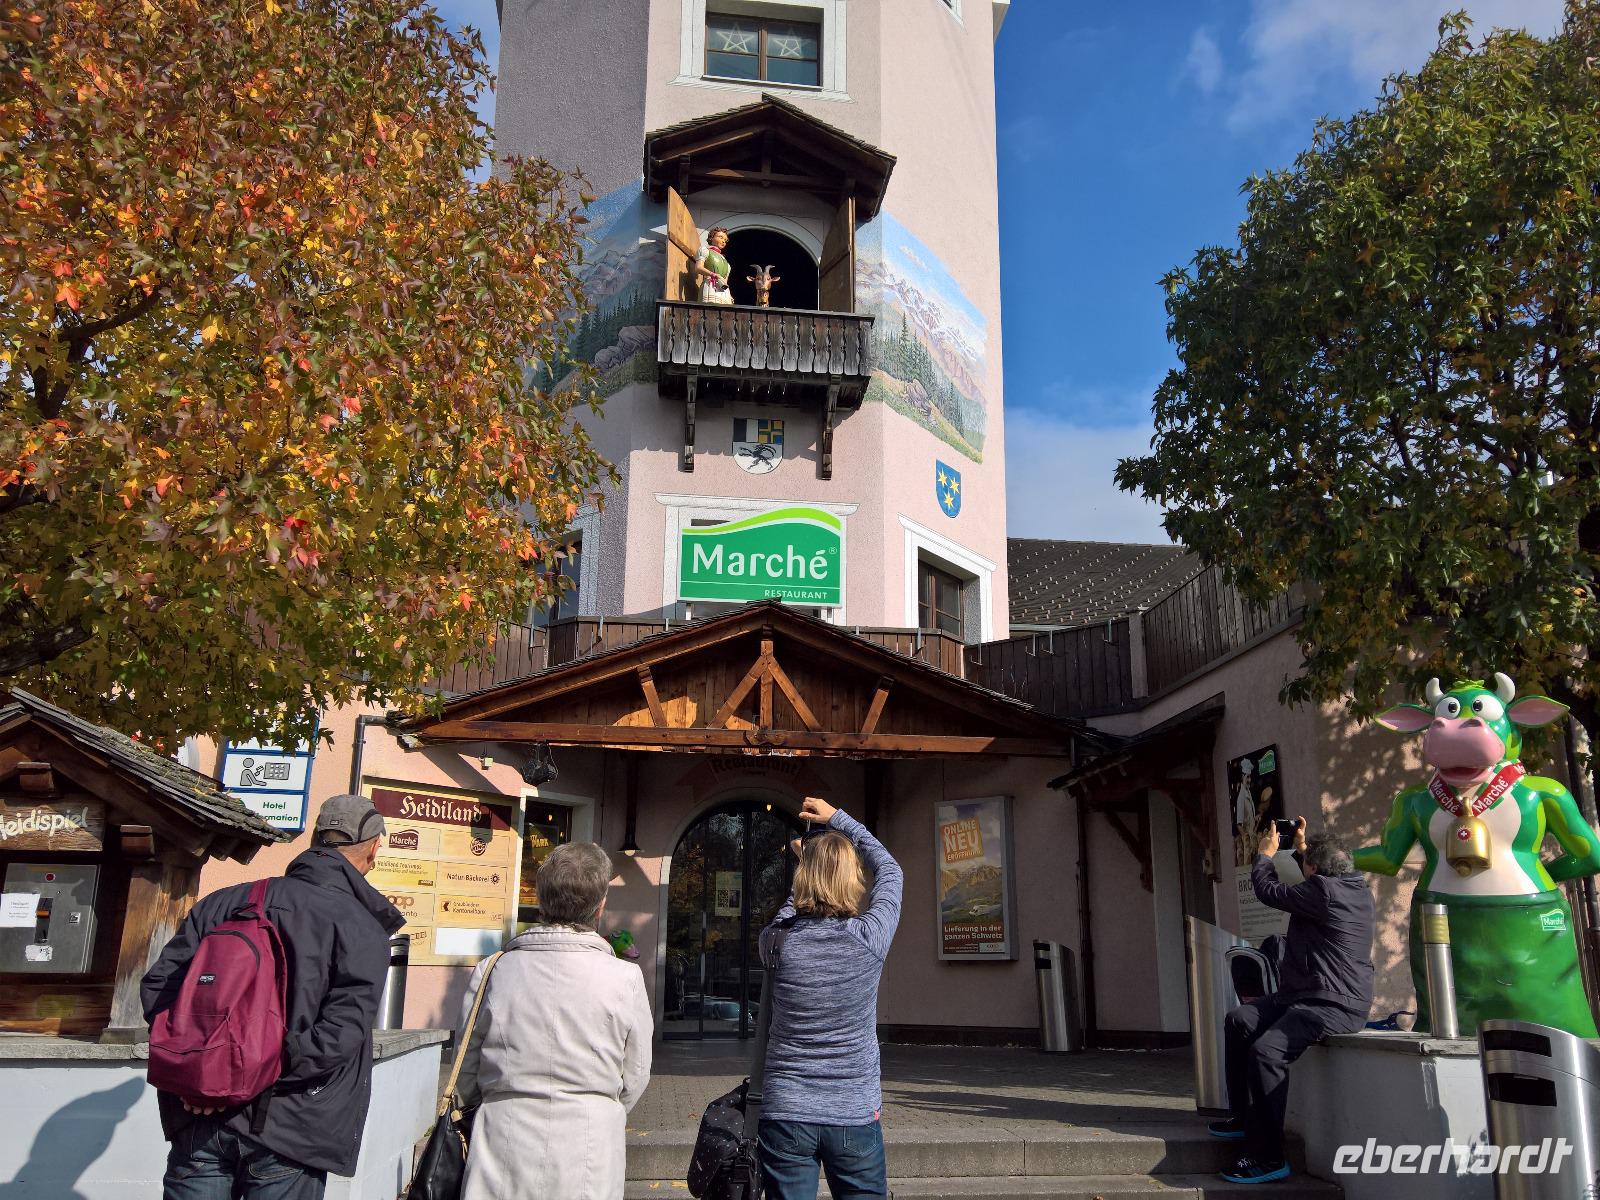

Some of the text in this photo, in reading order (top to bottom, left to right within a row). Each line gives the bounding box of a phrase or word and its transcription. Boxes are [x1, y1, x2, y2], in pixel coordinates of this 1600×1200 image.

[692, 543, 828, 580] Marché
[764, 589, 828, 600] RESTAURANT
[1472, 777, 1509, 814] Marché
[262, 801, 286, 810] Hotel
[400, 795, 482, 823] Heidiland
[943, 819, 977, 835] ONLINE
[944, 830, 979, 853] NEU
[387, 895, 415, 909] oop
[944, 925, 979, 933] Lieferung
[944, 933, 970, 941] ganzen
